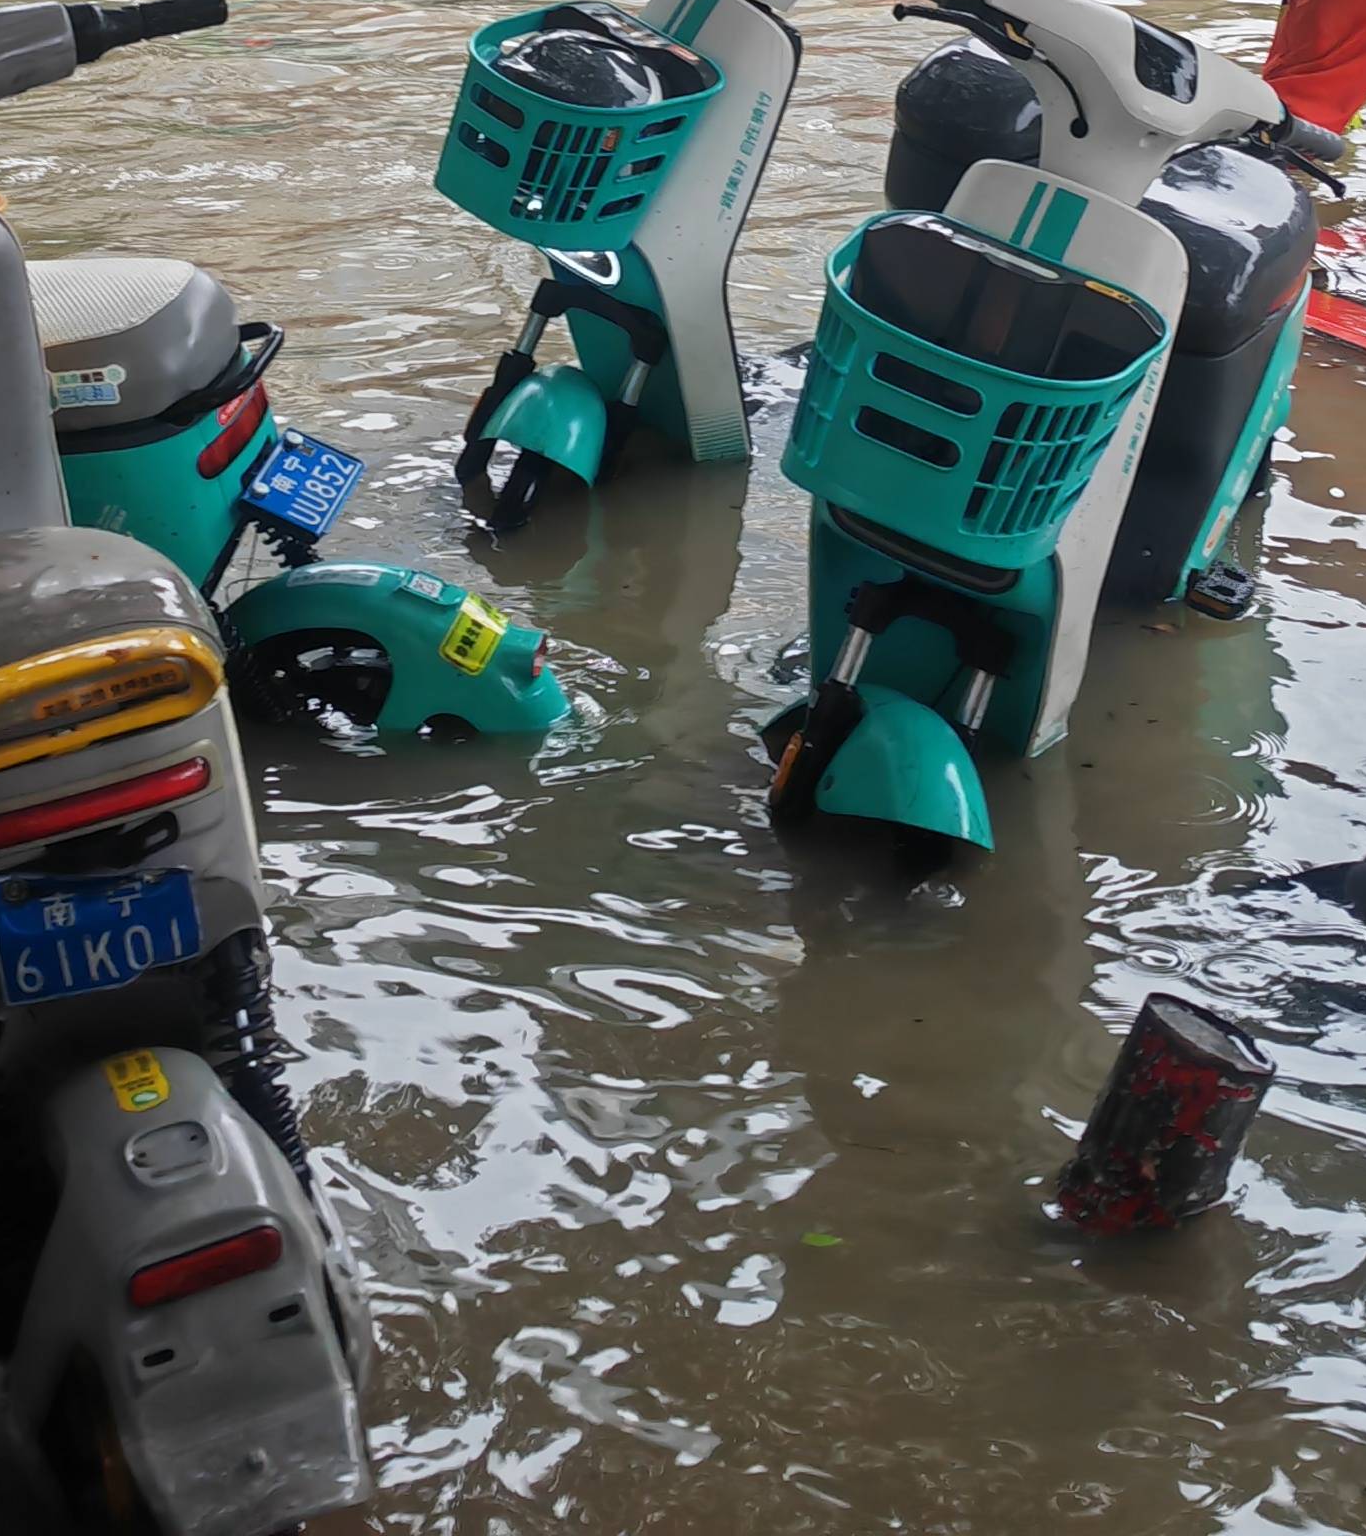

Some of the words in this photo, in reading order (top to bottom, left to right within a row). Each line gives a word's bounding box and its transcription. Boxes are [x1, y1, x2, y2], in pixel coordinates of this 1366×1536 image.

[270, 456, 308, 496] 南宁
[287, 454, 354, 526] UU852
[40, 881, 143, 931] 南宁
[16, 918, 183, 993] 61K01
